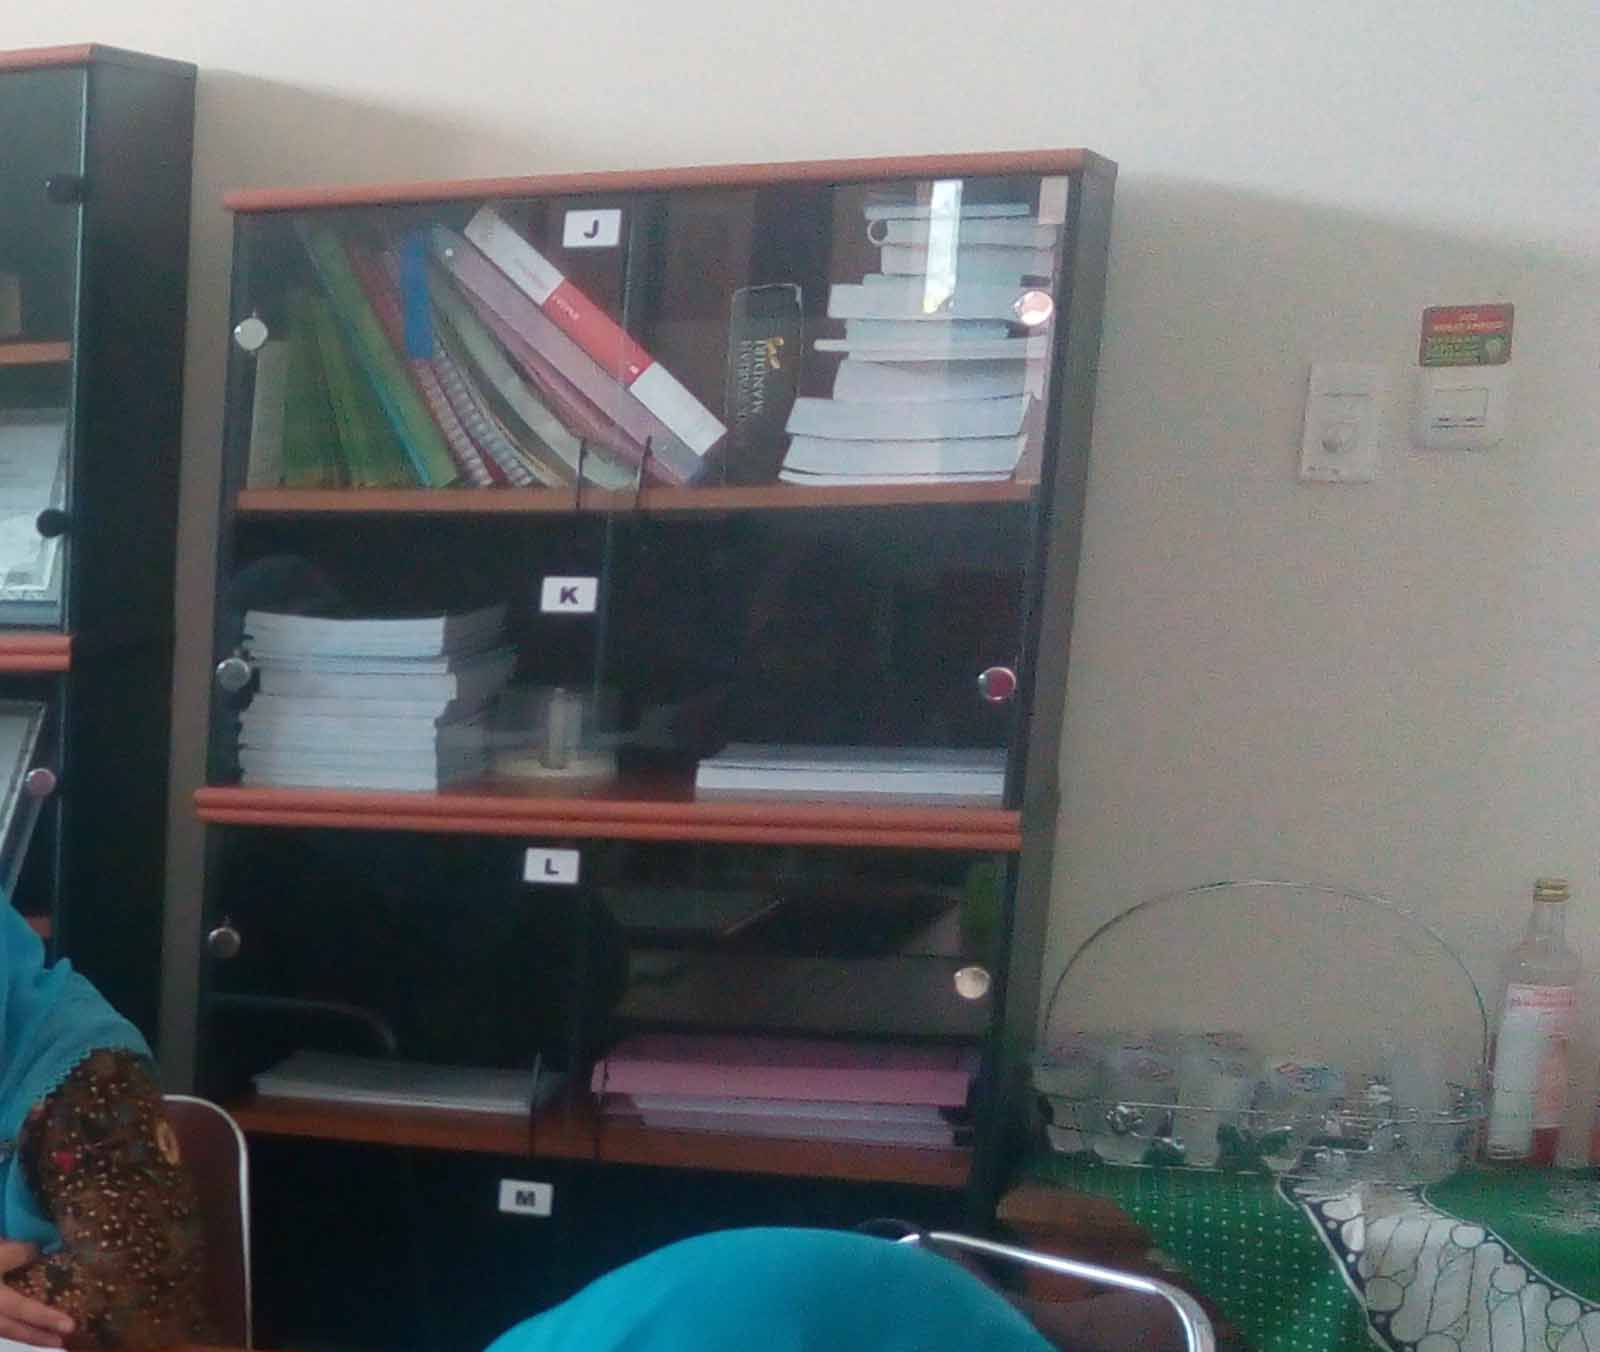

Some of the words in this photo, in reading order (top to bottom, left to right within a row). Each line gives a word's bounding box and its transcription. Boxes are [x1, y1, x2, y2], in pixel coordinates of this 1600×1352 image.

[583, 219, 600, 239] J
[559, 586, 579, 605] K
[544, 857, 560, 876] L
[514, 1189, 537, 1208] M
